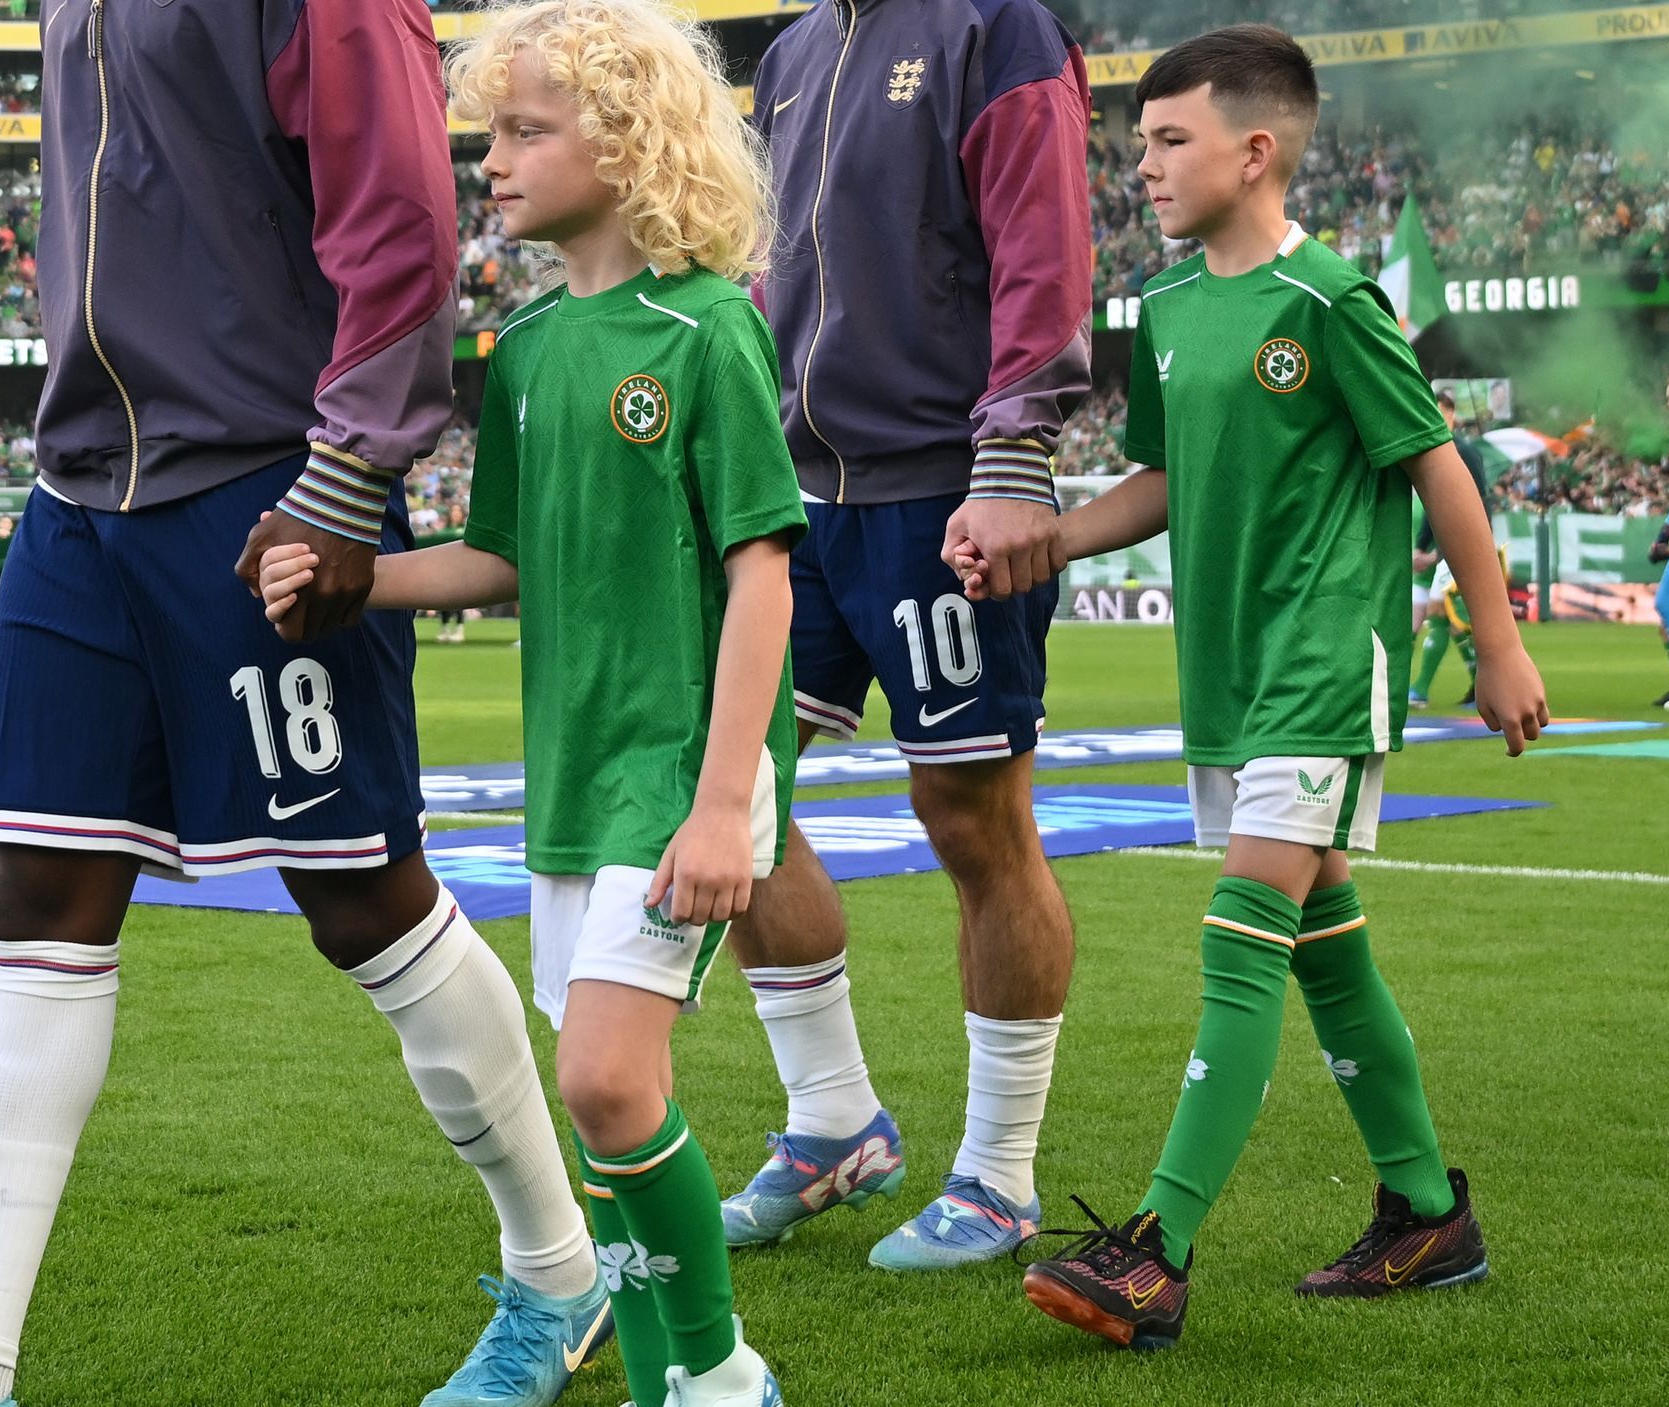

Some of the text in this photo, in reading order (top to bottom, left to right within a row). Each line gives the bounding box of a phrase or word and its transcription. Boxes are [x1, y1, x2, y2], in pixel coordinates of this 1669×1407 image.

[1433, 22, 1521, 47] AVIVA
[1087, 60, 1135, 79] IVA
[1444, 275, 1580, 313] GEORGIA
[1107, 297, 1141, 329] RE
[618, 380, 663, 401] IRELAND
[893, 593, 983, 691] 10
[229, 657, 343, 779] 18
[639, 926, 685, 944] CASTORE
